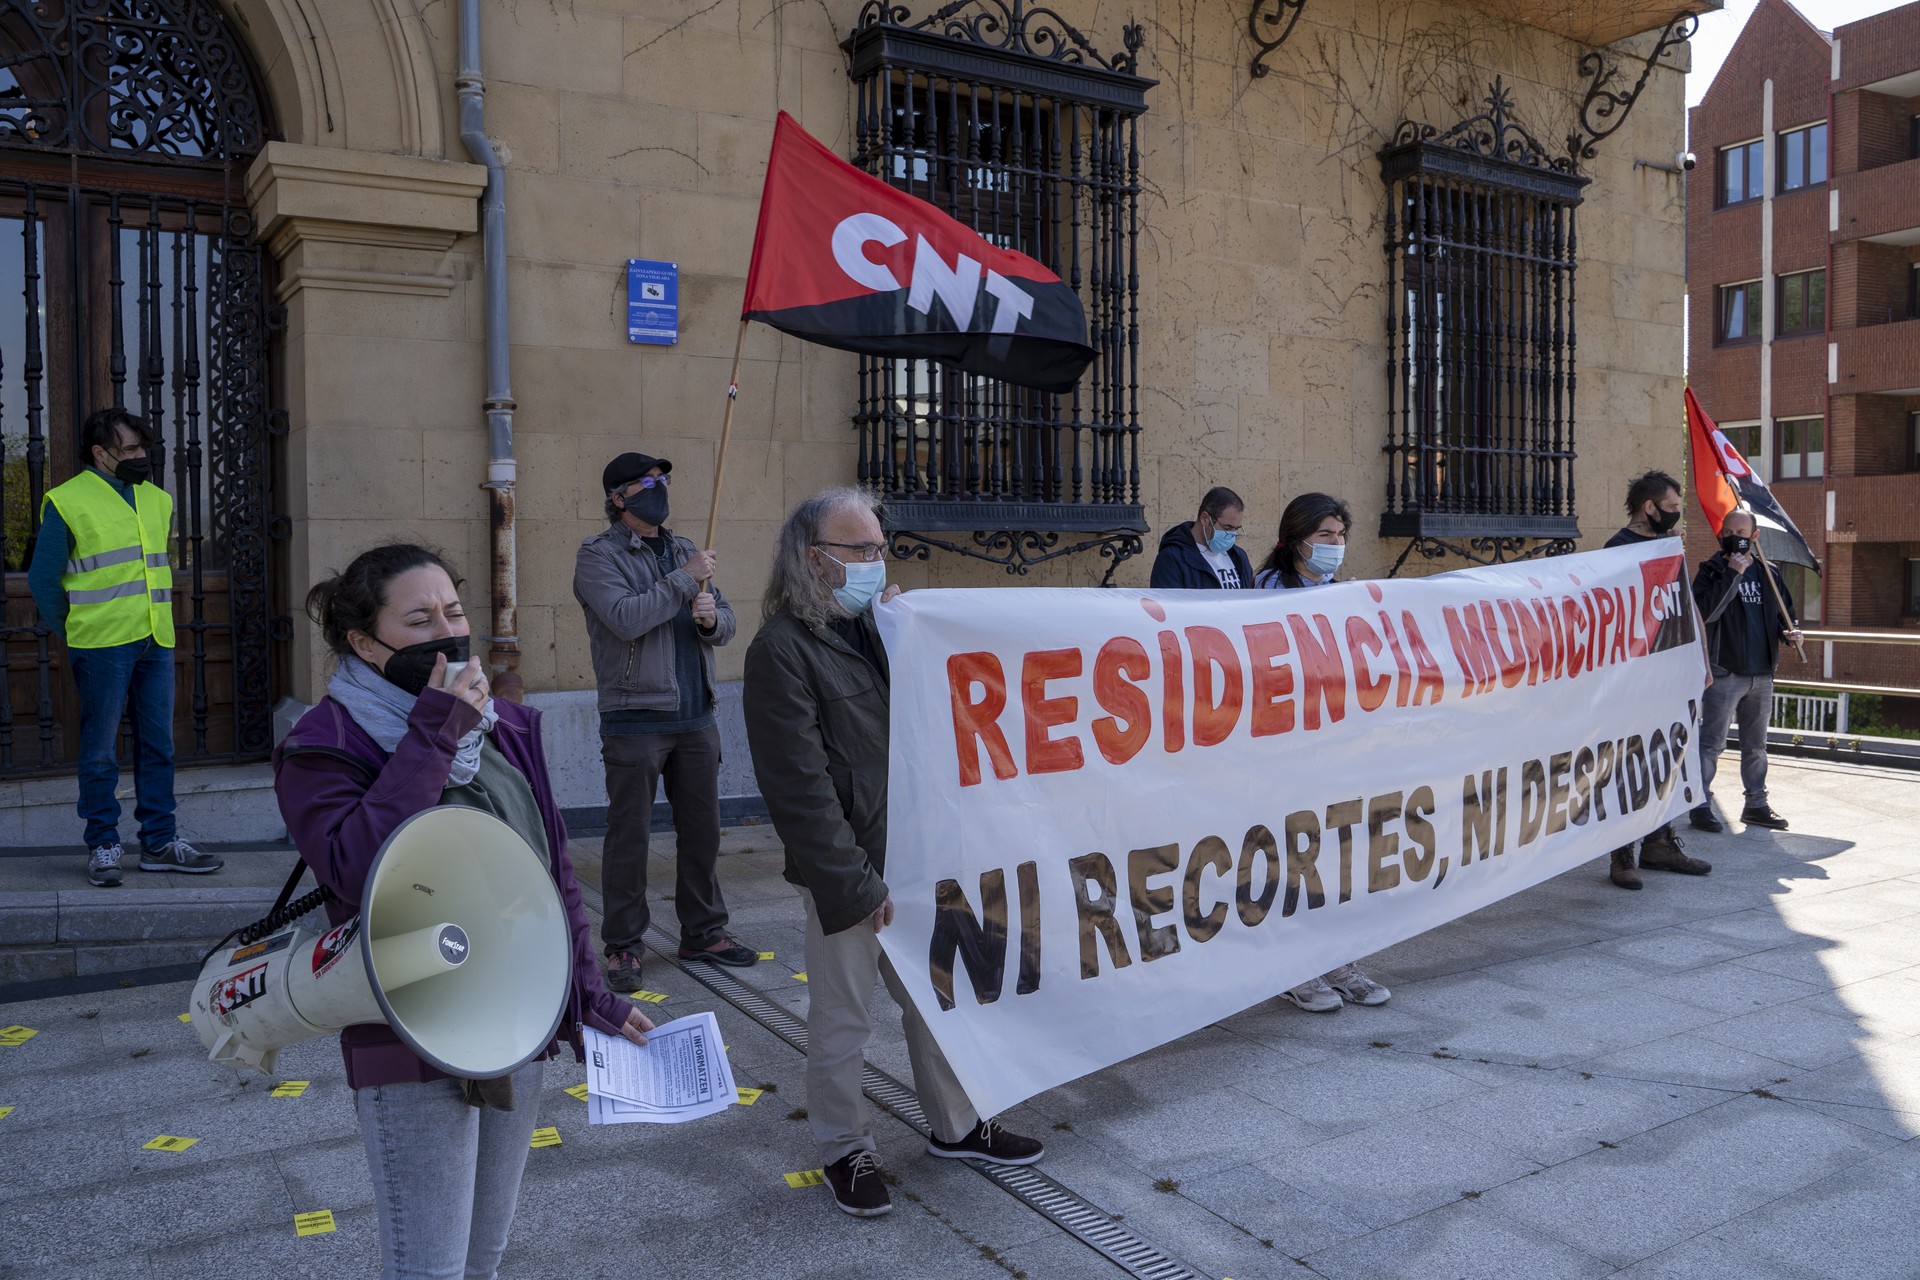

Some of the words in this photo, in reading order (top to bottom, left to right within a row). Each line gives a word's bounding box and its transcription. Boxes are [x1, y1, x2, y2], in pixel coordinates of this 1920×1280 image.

[831, 213, 1034, 335] CNT
[1650, 581, 1682, 621] CNT
[929, 861, 1041, 1011] NI
[1069, 785, 1449, 981] RECORTES,
[1461, 767, 1508, 867] NI
[219, 966, 265, 1009] CNT
[594, 1052, 602, 1067] CNT
[693, 1034, 708, 1094] INFORMATZEN
